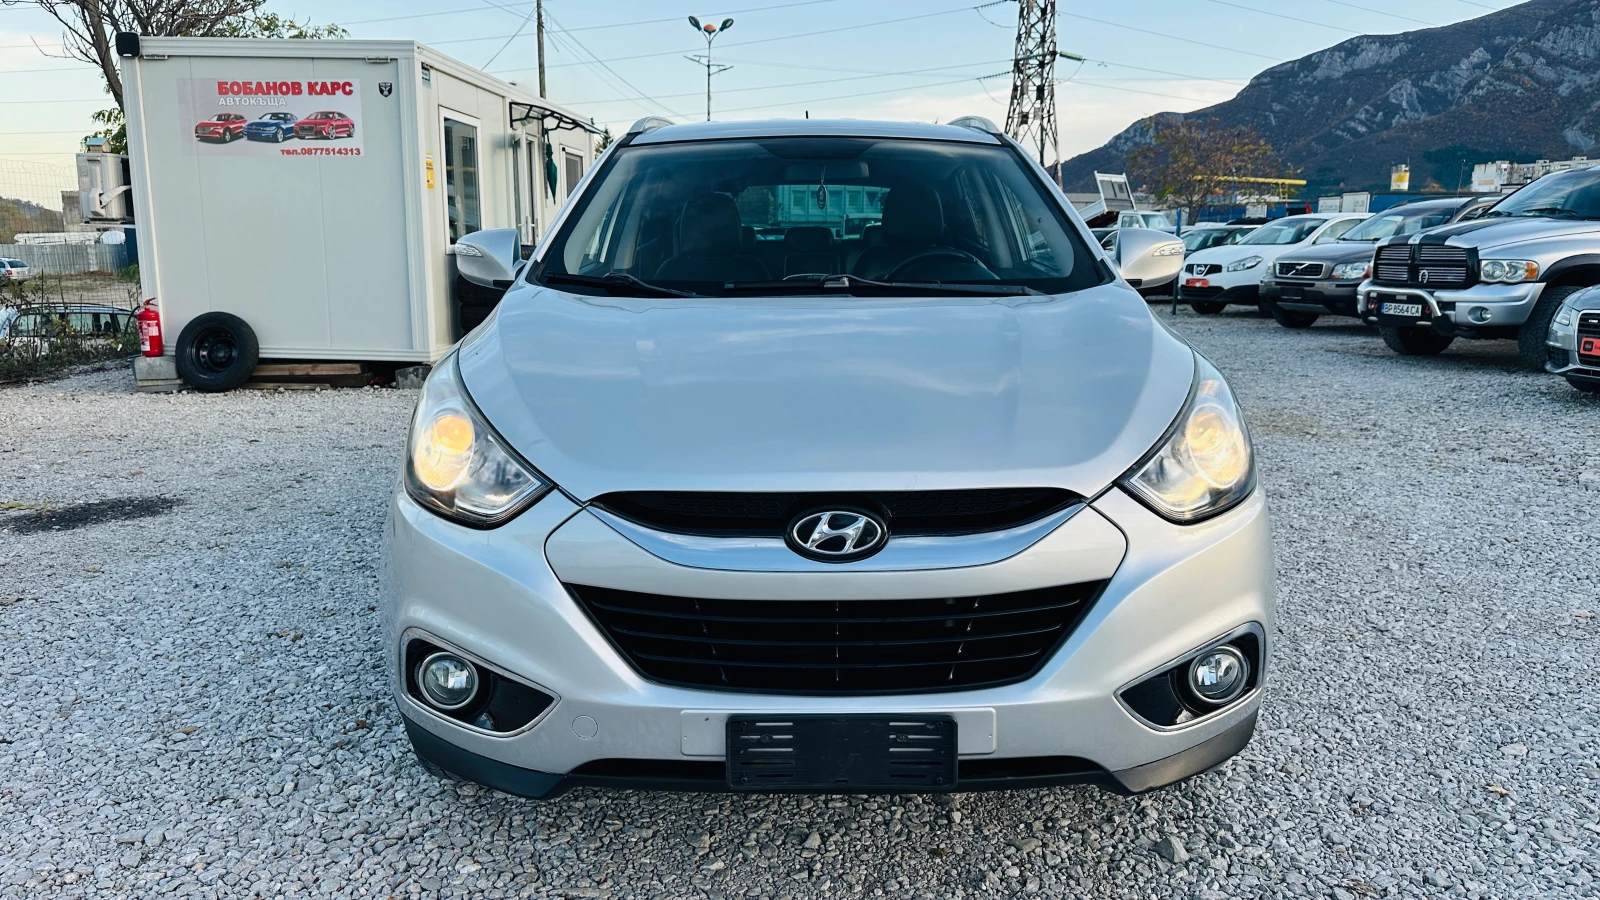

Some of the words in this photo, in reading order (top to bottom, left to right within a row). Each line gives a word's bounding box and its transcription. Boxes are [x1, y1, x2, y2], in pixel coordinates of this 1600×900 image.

[217, 81, 303, 96] БОБАНОВ
[307, 81, 354, 96] КАРС
[218, 97, 287, 107] АВТОКЪЩА
[280, 147, 361, 156] тел.0877514313
